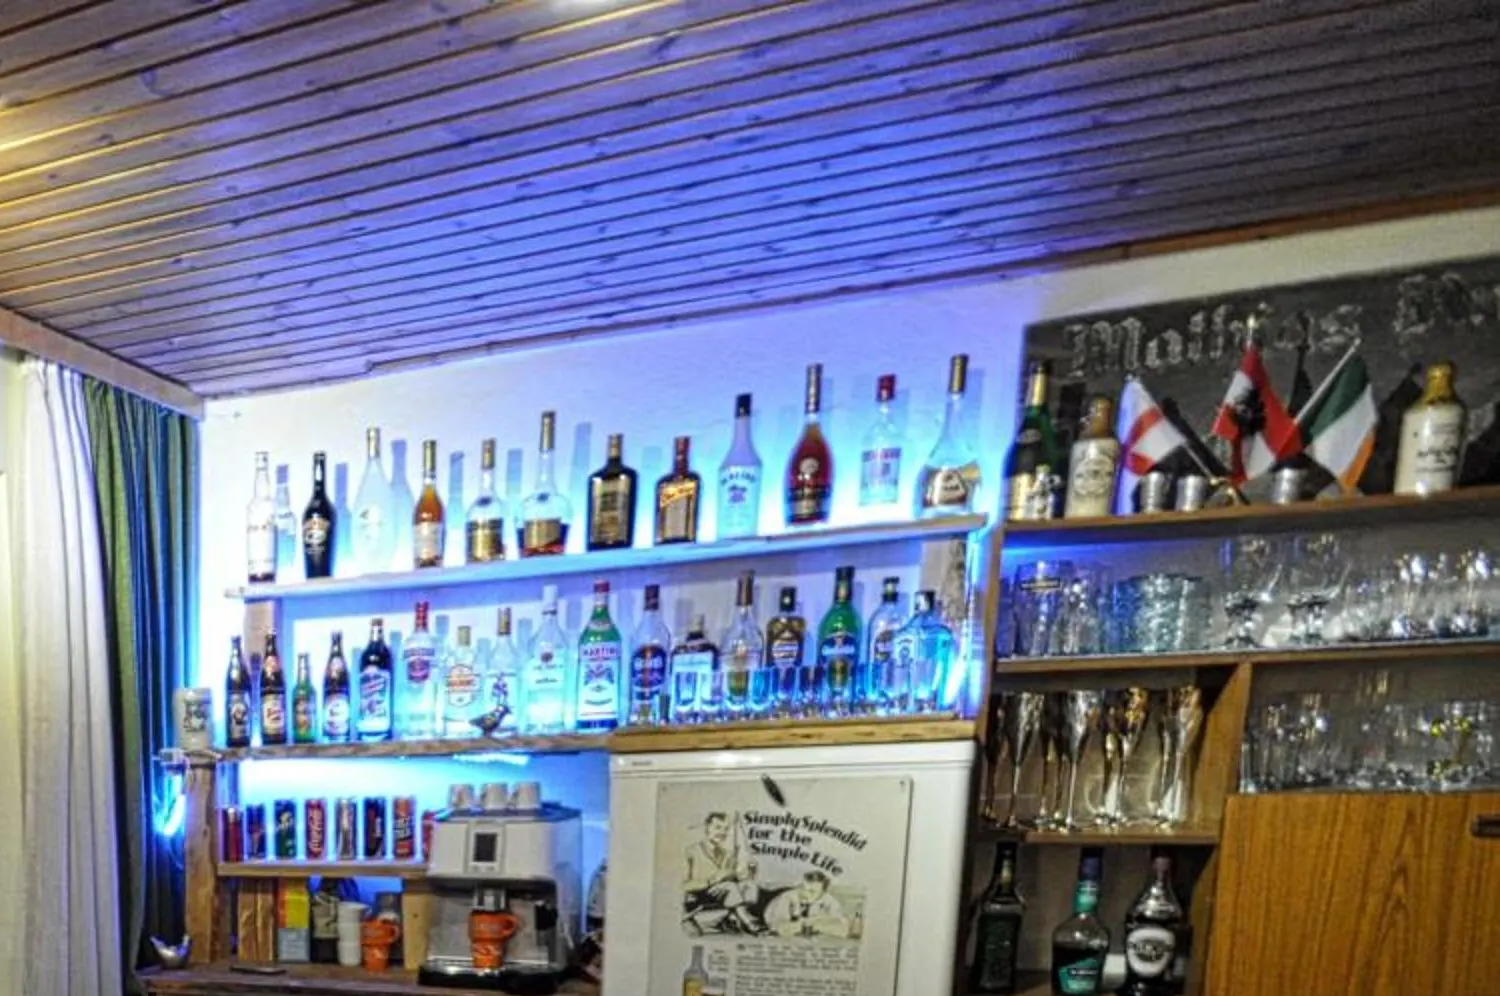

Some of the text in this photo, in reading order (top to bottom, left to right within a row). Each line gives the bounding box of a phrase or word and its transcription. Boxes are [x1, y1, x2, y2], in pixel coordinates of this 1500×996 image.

[744, 811, 868, 850] Simply Splendid
[748, 827, 812, 845] for the
[750, 842, 843, 877] Simple Life
